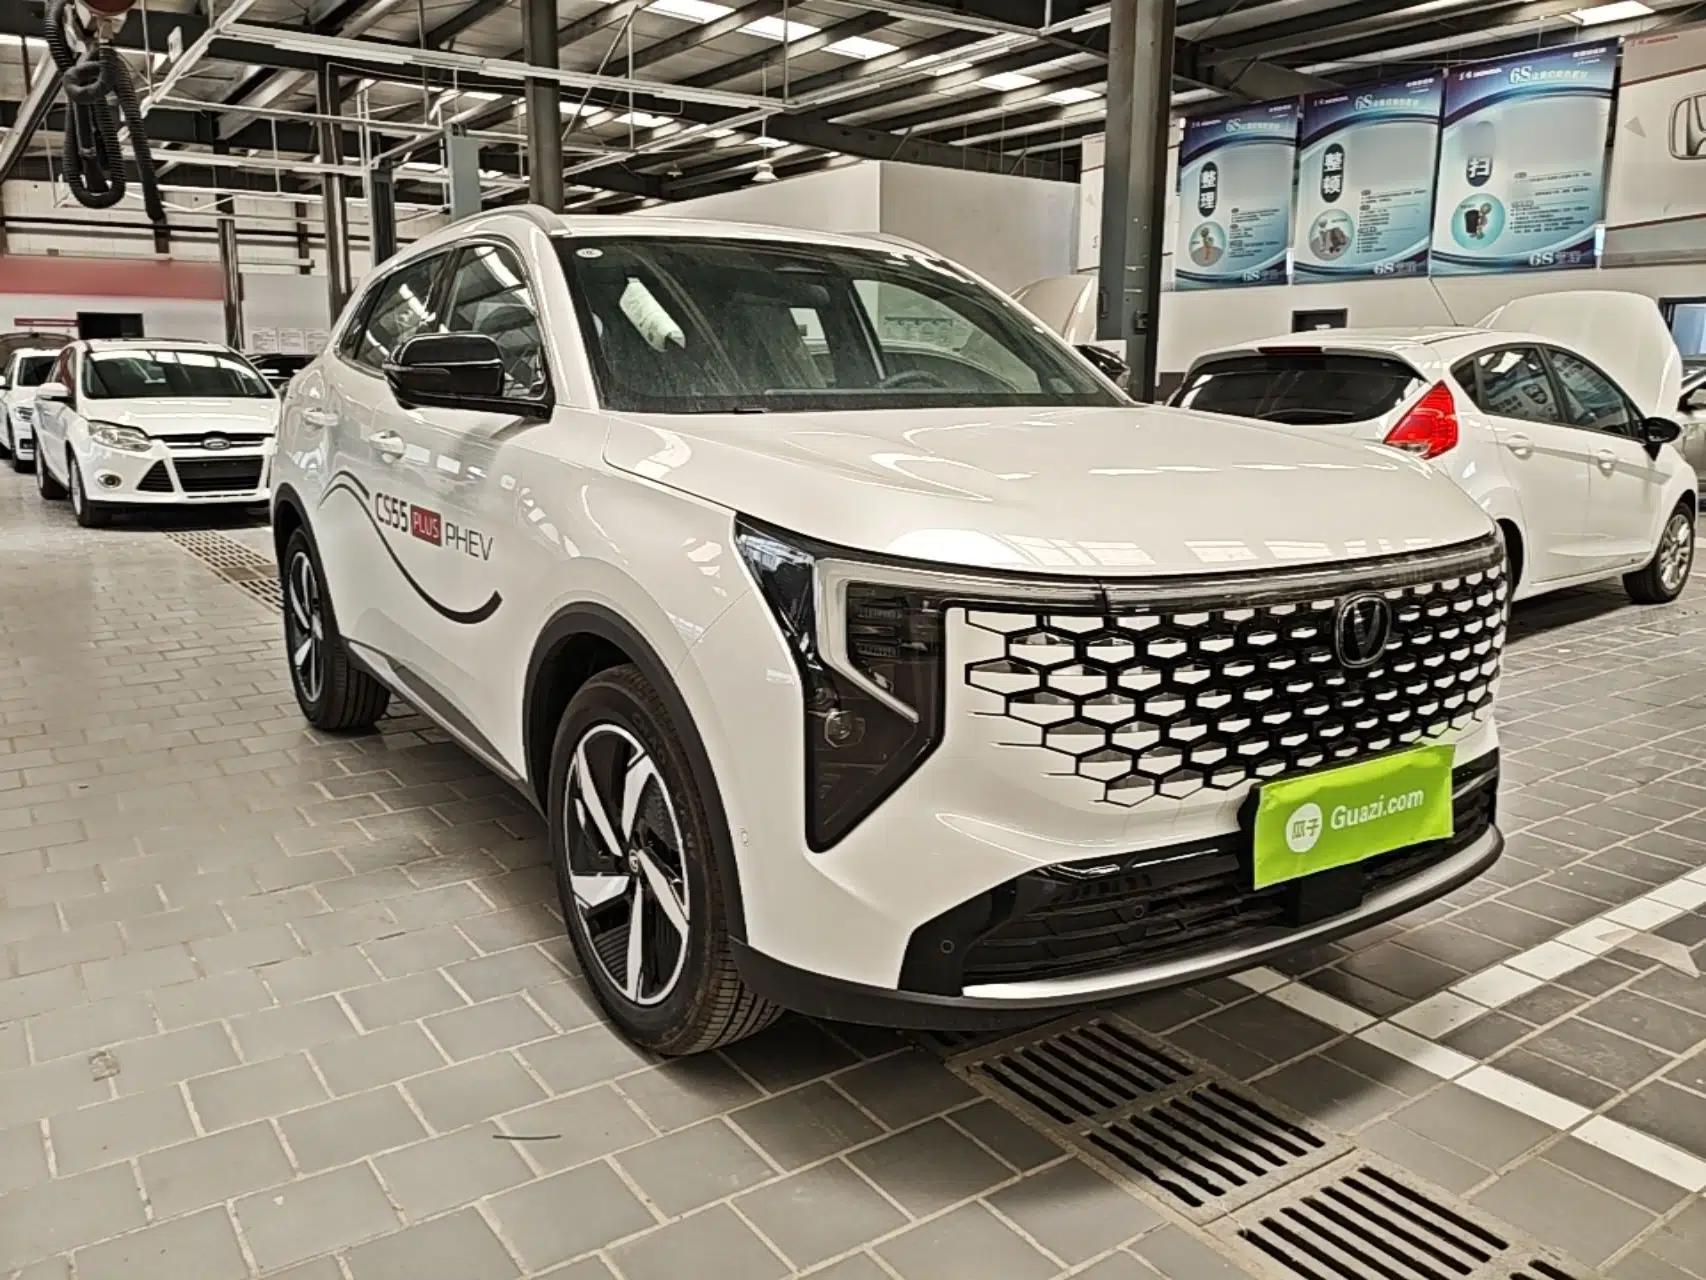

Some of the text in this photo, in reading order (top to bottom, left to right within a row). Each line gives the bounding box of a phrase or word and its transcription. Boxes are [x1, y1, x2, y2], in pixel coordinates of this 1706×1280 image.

[375, 492, 493, 561] CS55 PLUS PHEV
[1291, 789, 1424, 840] 瓜子 Guazi.com
